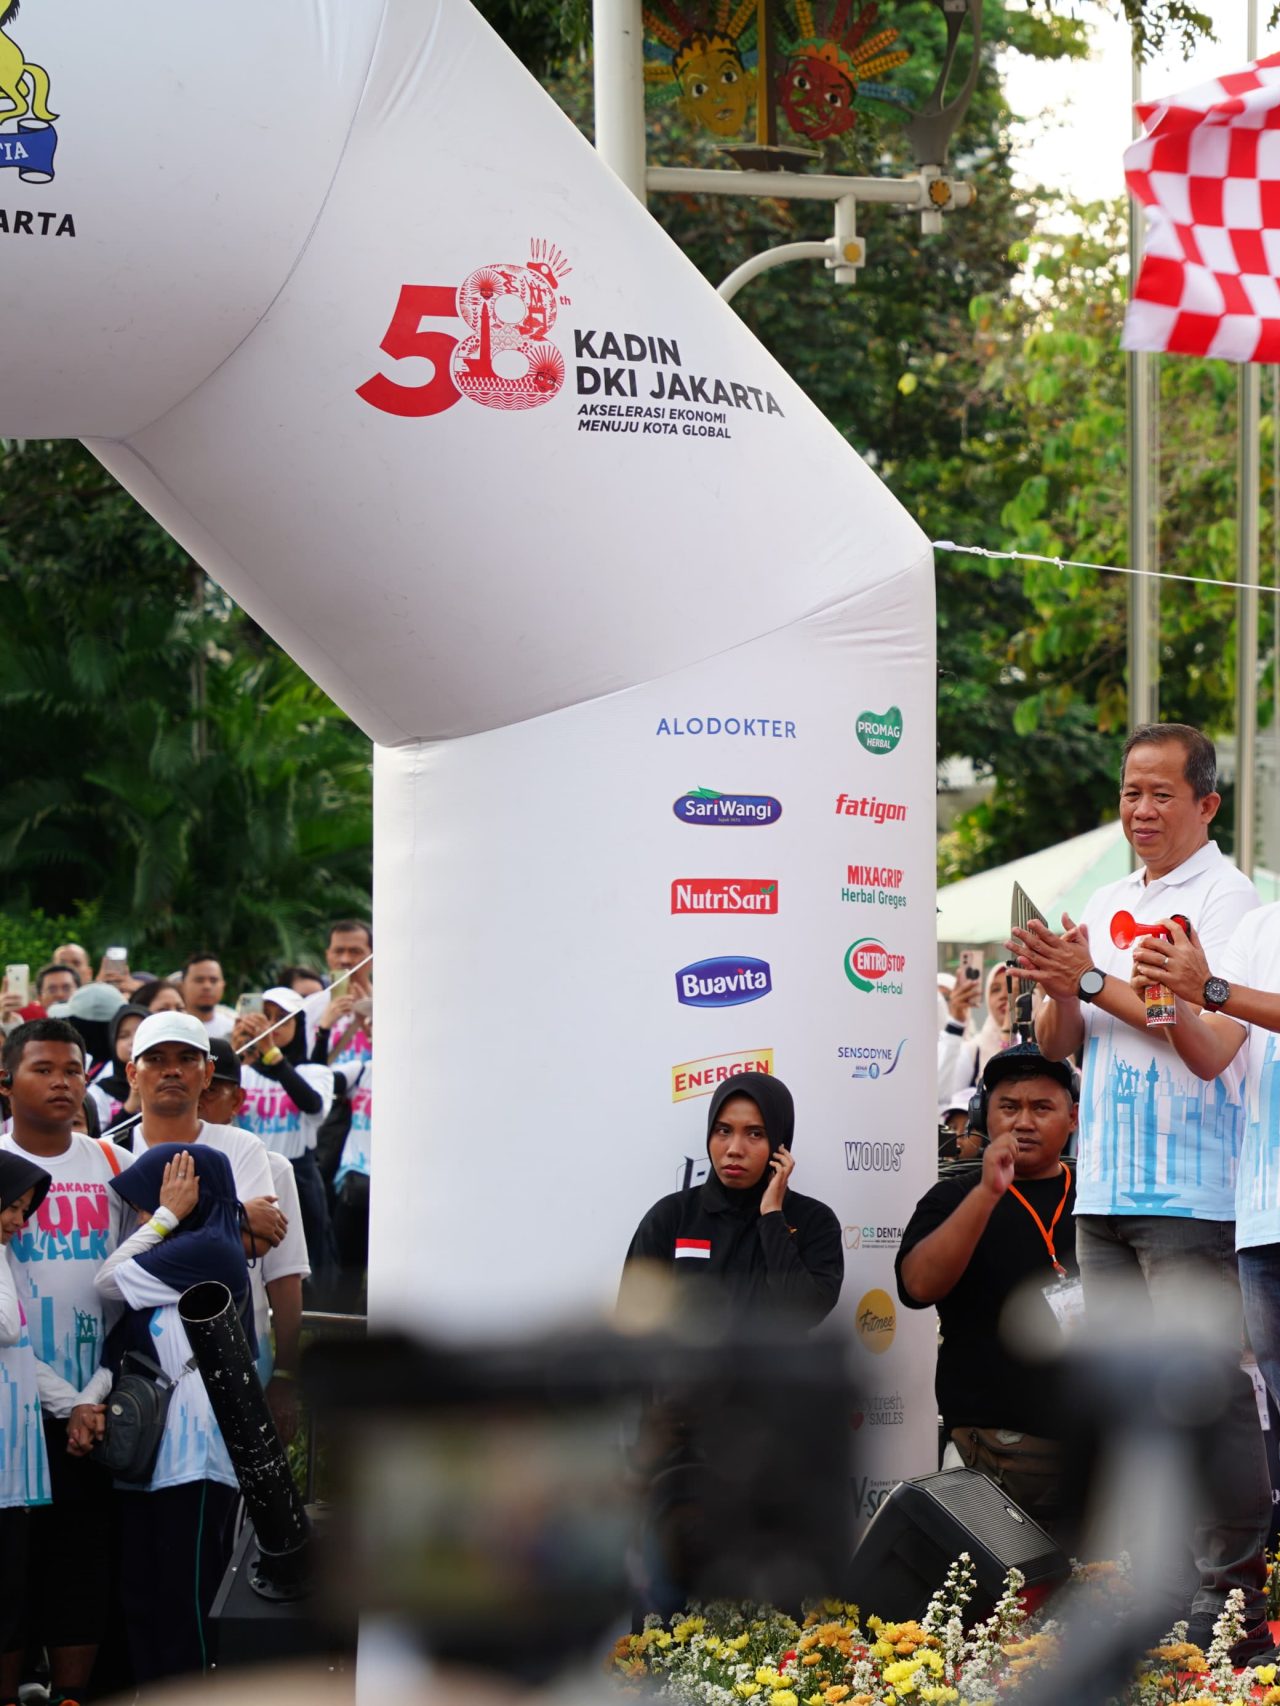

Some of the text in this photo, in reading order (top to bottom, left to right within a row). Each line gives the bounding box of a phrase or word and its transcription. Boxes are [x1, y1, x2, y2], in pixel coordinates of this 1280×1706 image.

[573, 329, 681, 367] KADIN
[576, 365, 786, 418] DKI JAKARTA
[578, 403, 727, 424] AKSELERASI EKONOMI
[578, 419, 731, 439] MENUJU KOTA GLOBAL
[656, 717, 796, 739] ALODOKTER
[857, 721, 900, 738] PROMAG
[867, 737, 891, 749] HERBAL
[685, 799, 772, 820] SariWangi
[835, 793, 906, 824] fatigon
[847, 864, 903, 888] MIXAGRIP
[676, 885, 770, 910] NutriSari
[841, 887, 907, 909] Herbal Greges
[682, 968, 767, 998] Buavita
[876, 981, 903, 995] Herbal
[838, 1046, 893, 1060] SENSODYNE
[675, 1060, 769, 1092] ENERGEN
[862, 1227, 875, 1238] CS
[869, 1411, 904, 1426] SMILES
